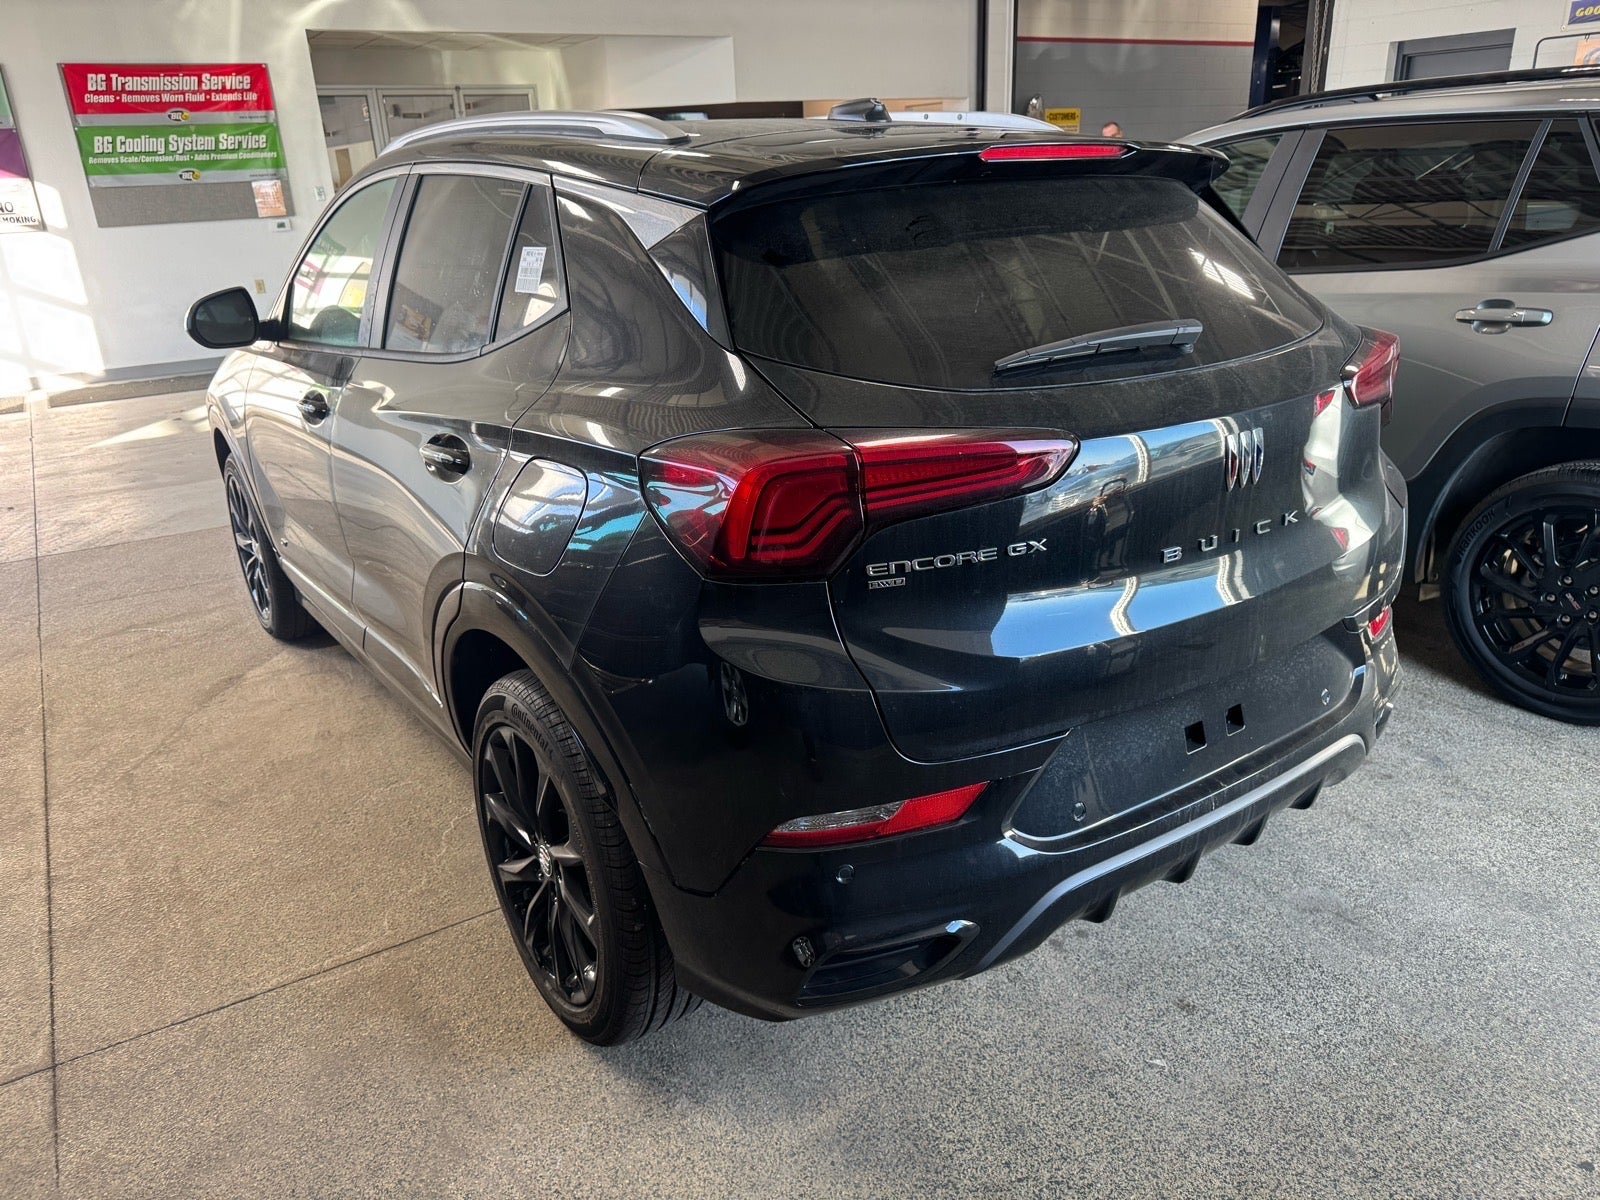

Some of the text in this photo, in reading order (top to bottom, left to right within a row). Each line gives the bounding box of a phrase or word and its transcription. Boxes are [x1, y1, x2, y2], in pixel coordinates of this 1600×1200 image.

[86, 72, 251, 92] BG Transmission Service
[84, 91, 258, 104] Cleans Removes Worn Fluid Extends Life
[93, 132, 267, 155] BG Cooling System Service
[88, 156, 119, 165] Removes
[0, 215, 36, 224] MOKING
[1161, 510, 1299, 563] BUICK
[866, 538, 1048, 577] ENCORE GX
